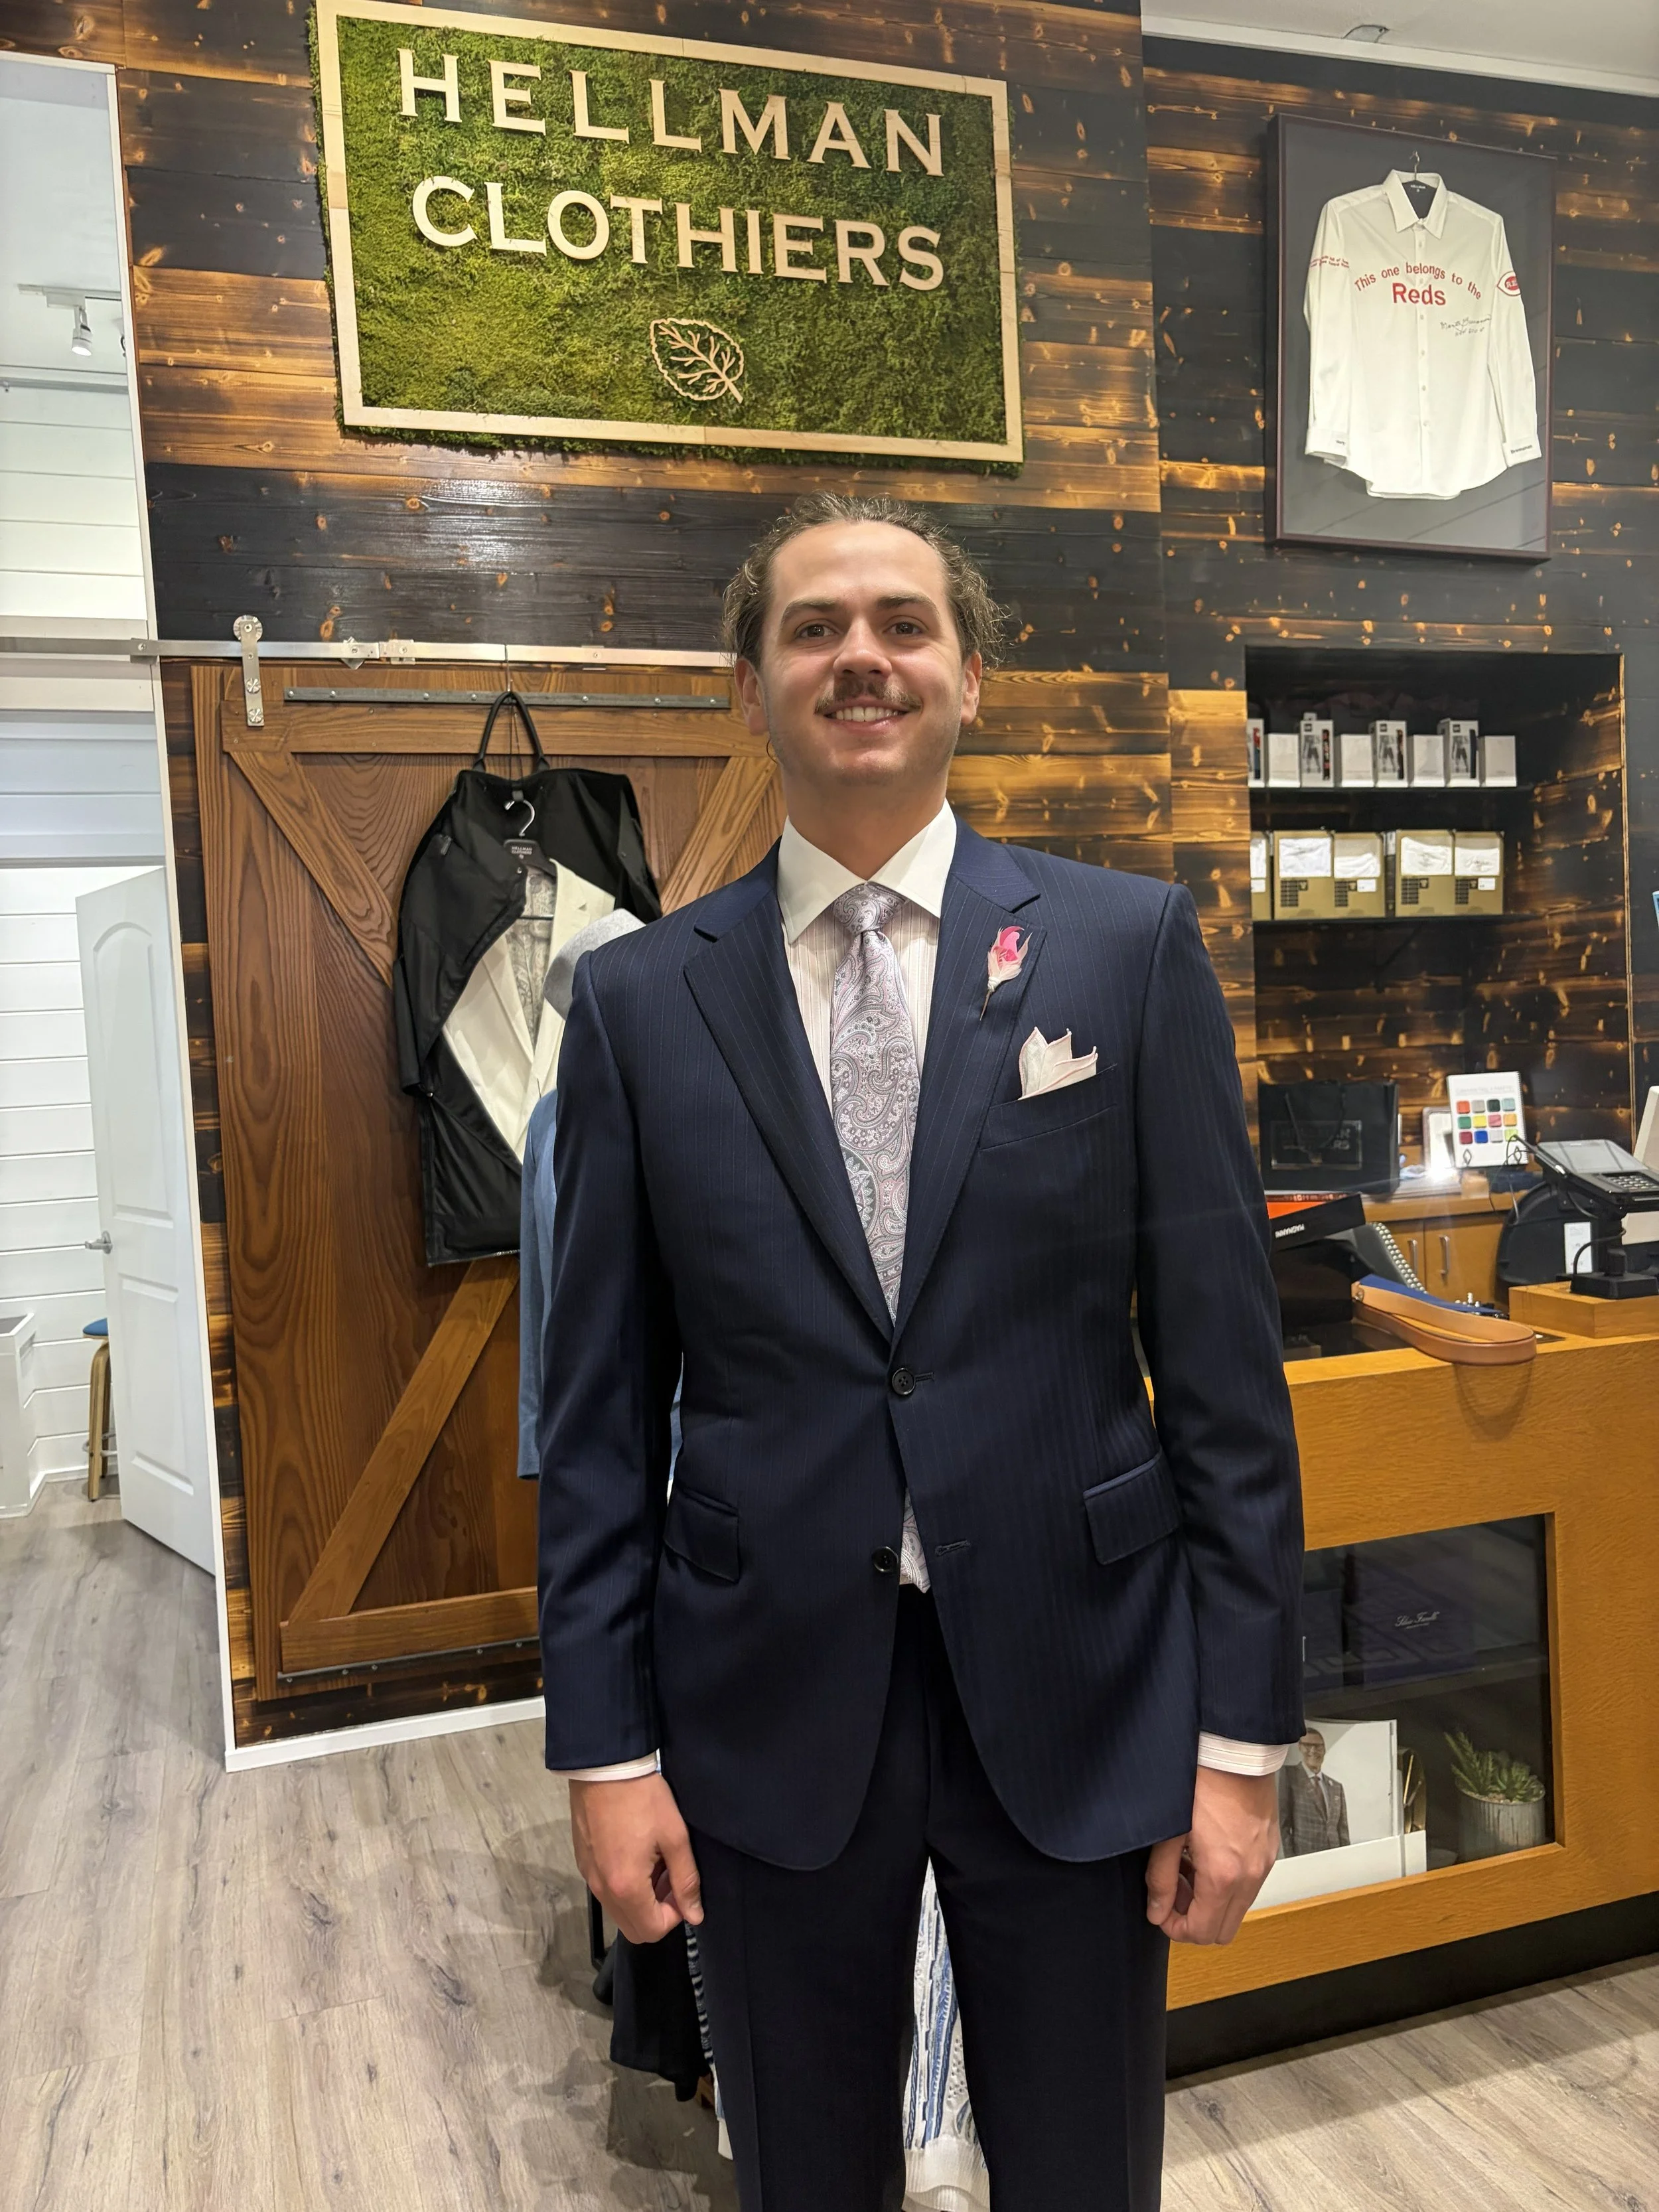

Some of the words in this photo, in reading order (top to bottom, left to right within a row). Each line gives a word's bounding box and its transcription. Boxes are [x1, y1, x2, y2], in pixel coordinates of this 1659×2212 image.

[398, 48, 945, 177] HELLMAN
[411, 175, 945, 291] CLOTHIERS
[1354, 273, 1376, 291] This
[1381, 266, 1400, 279] one
[1406, 261, 1446, 280] belongs
[1451, 272, 1463, 285] to
[1467, 281, 1481, 300] the
[1392, 282, 1447, 306] Reds
